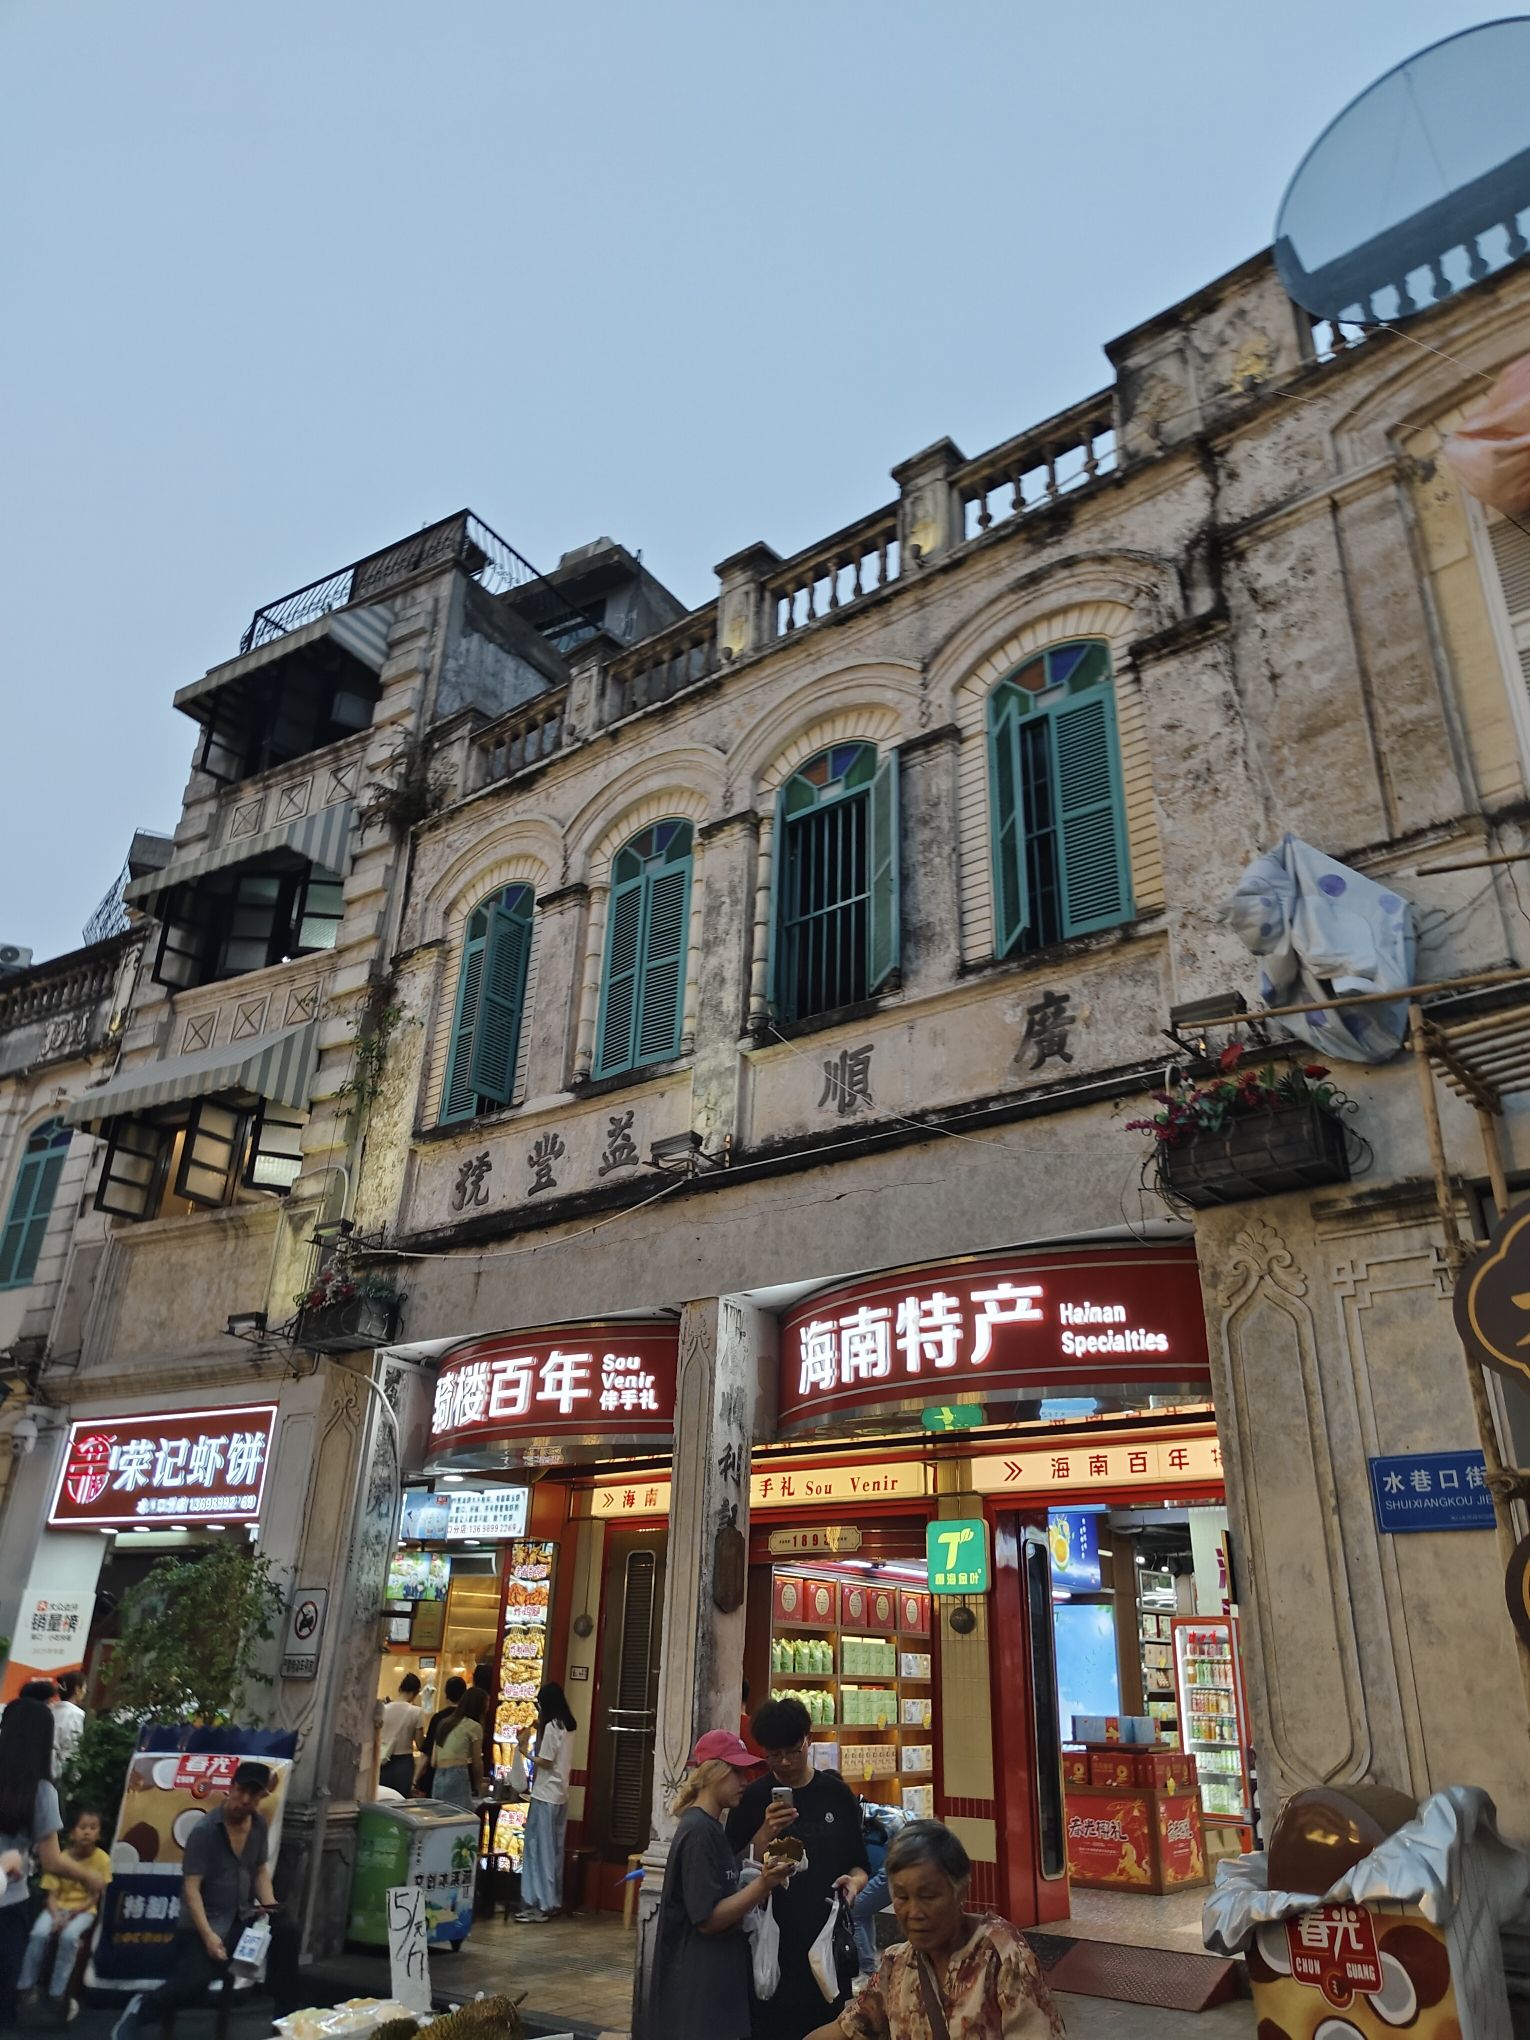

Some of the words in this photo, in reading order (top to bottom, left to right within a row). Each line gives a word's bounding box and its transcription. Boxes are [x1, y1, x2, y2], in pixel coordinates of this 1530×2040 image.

[1059, 1301, 1127, 1325] Hainan
[798, 1283, 1044, 1395] 海南特产
[1061, 1328, 1170, 1358] Specialties
[602, 1353, 641, 1371] Sou
[432, 1350, 594, 1435] 骑楼百年
[601, 1372, 656, 1391] Venir
[599, 1389, 659, 1412] 伴手礼
[112, 1432, 266, 1493] 荣记虾饼
[759, 1476, 796, 1499] 手礼
[805, 1480, 833, 1497] Sou
[850, 1474, 899, 1494] Venir
[1382, 1465, 1490, 1495] 水巷口街
[622, 1488, 658, 1508] 海南
[1385, 1495, 1473, 1511] SHUIXIANGKOU
[1295, 1957, 1321, 1975] CHUN
[1345, 1962, 1377, 1982] GUANG
